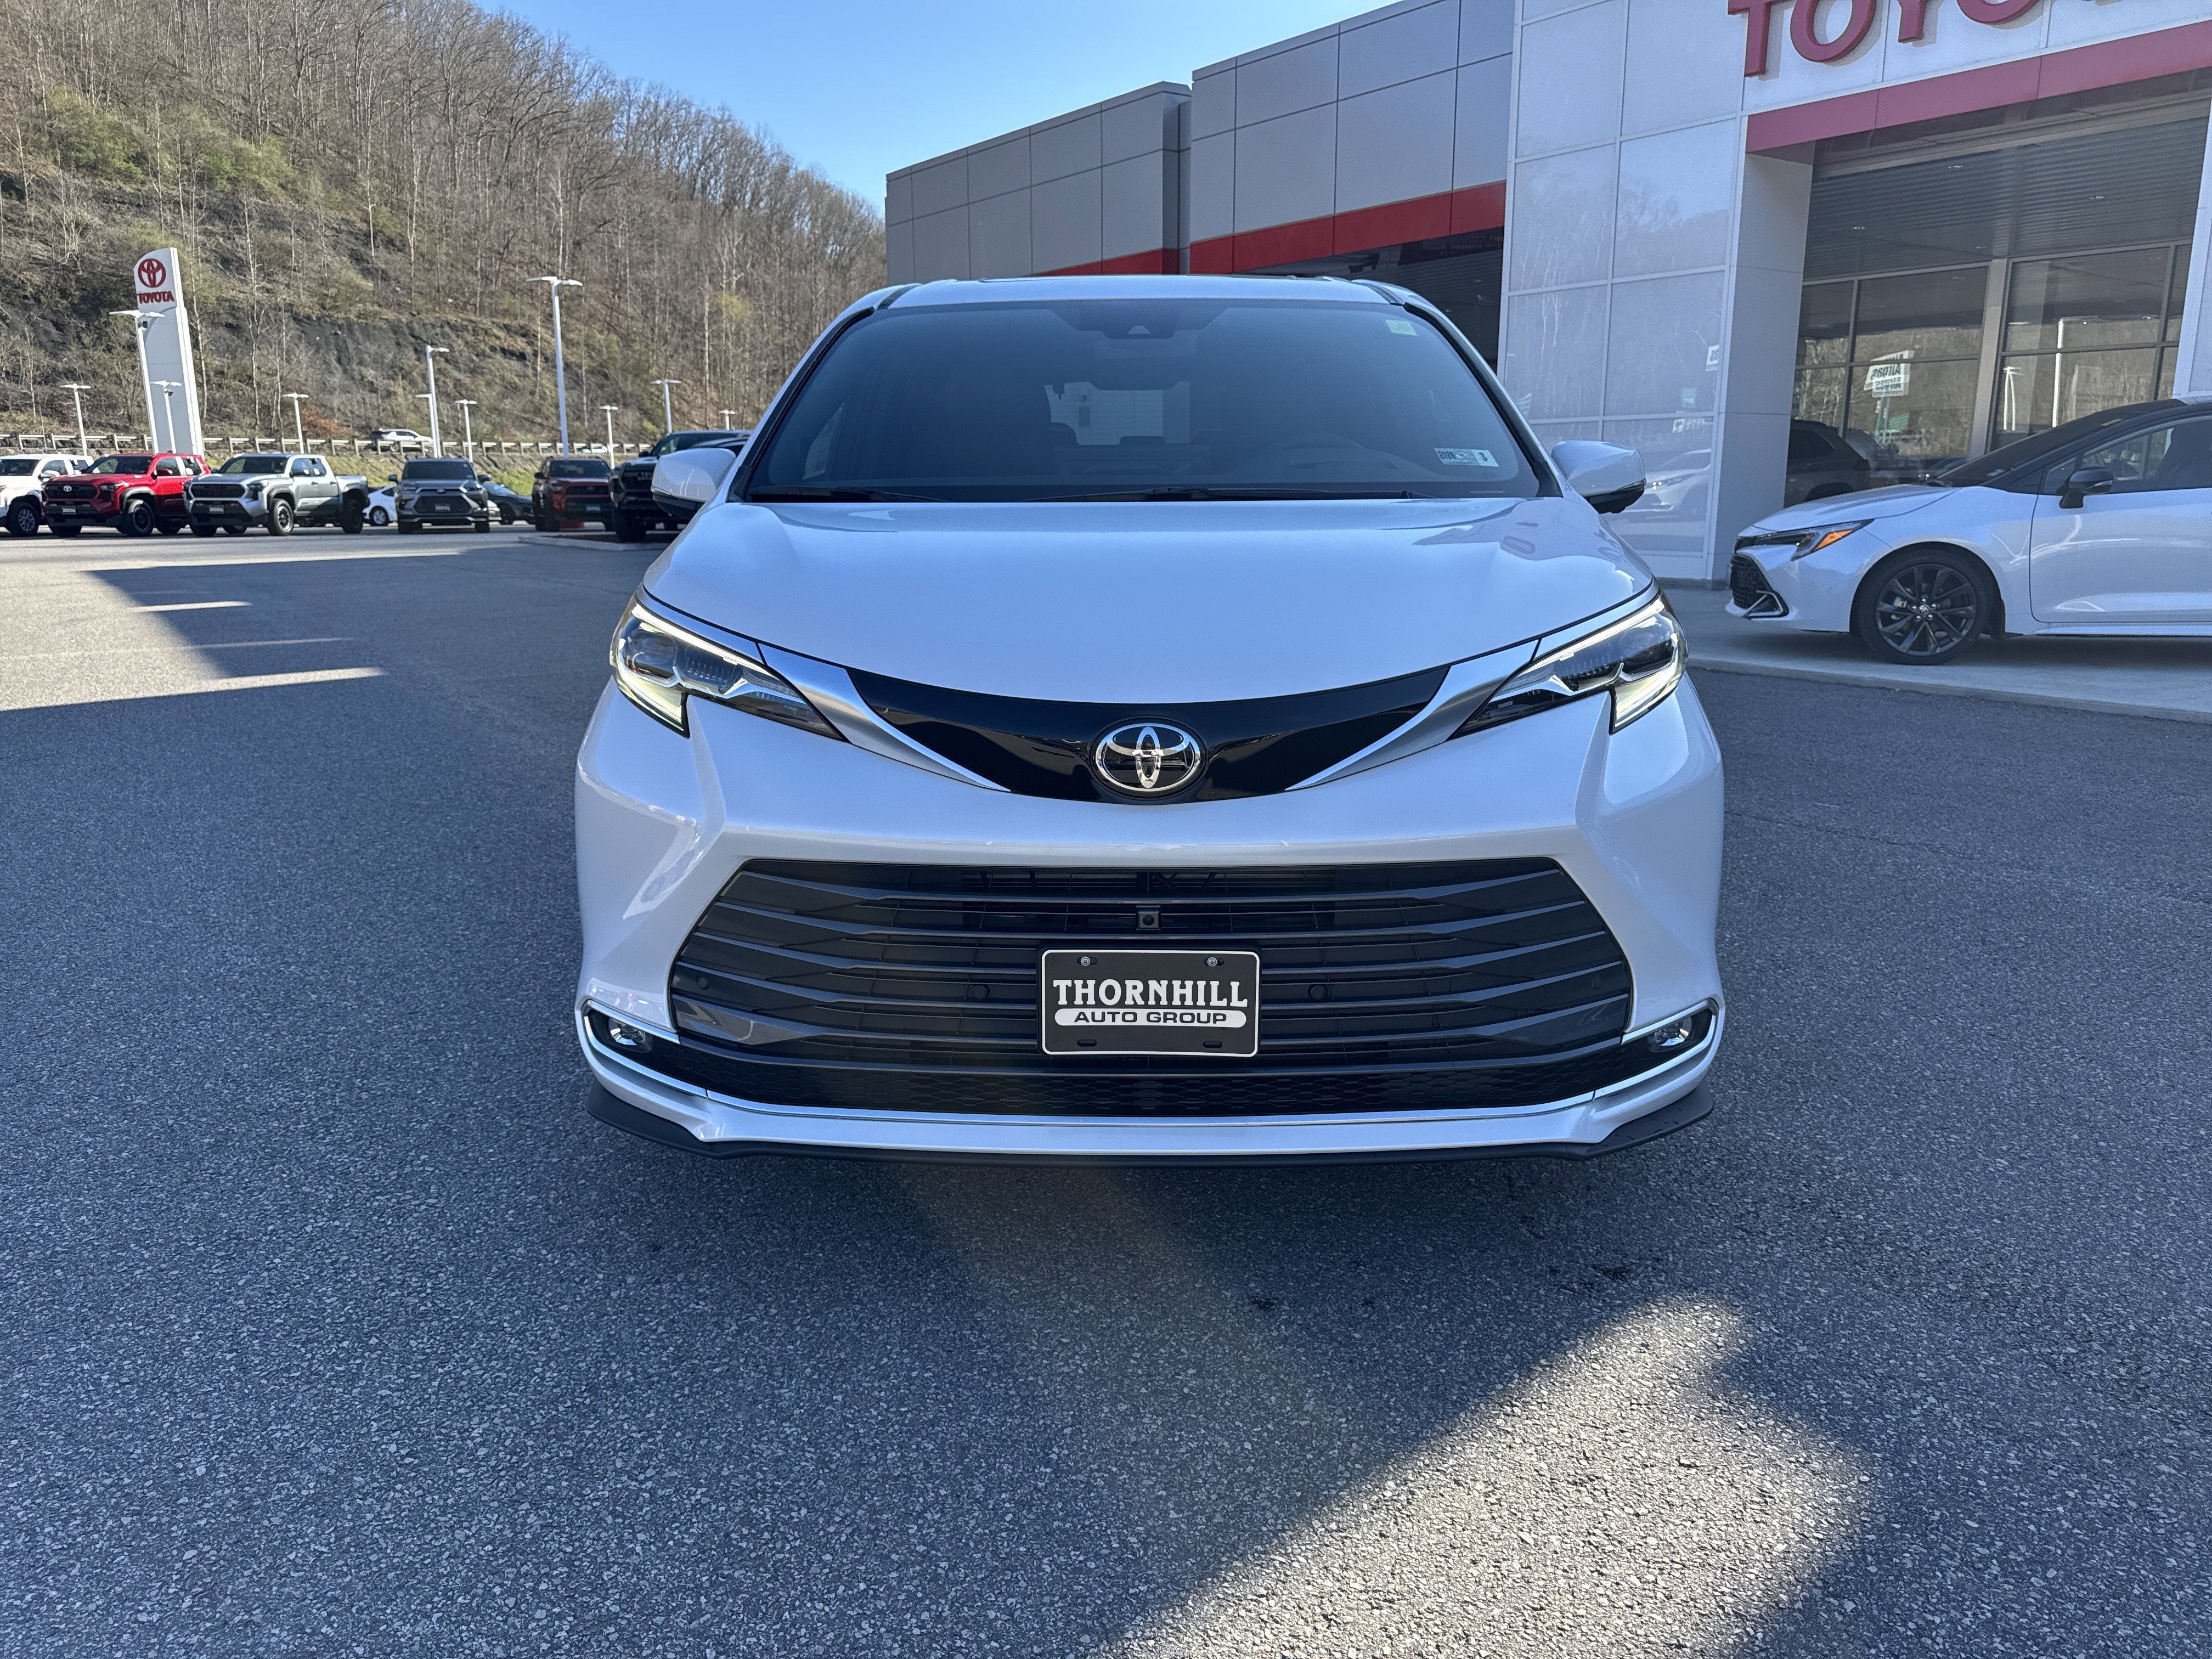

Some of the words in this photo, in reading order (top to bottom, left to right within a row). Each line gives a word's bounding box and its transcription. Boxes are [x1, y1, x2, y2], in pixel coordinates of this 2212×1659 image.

[1728, 0, 2095, 76] TOY
[137, 291, 175, 304] TOYOTA
[1478, 452, 1488, 461] 3
[1053, 979, 1248, 1007] THORNHILL
[1074, 1011, 1137, 1023] AUTO
[1147, 1012, 1227, 1024] GROUP
